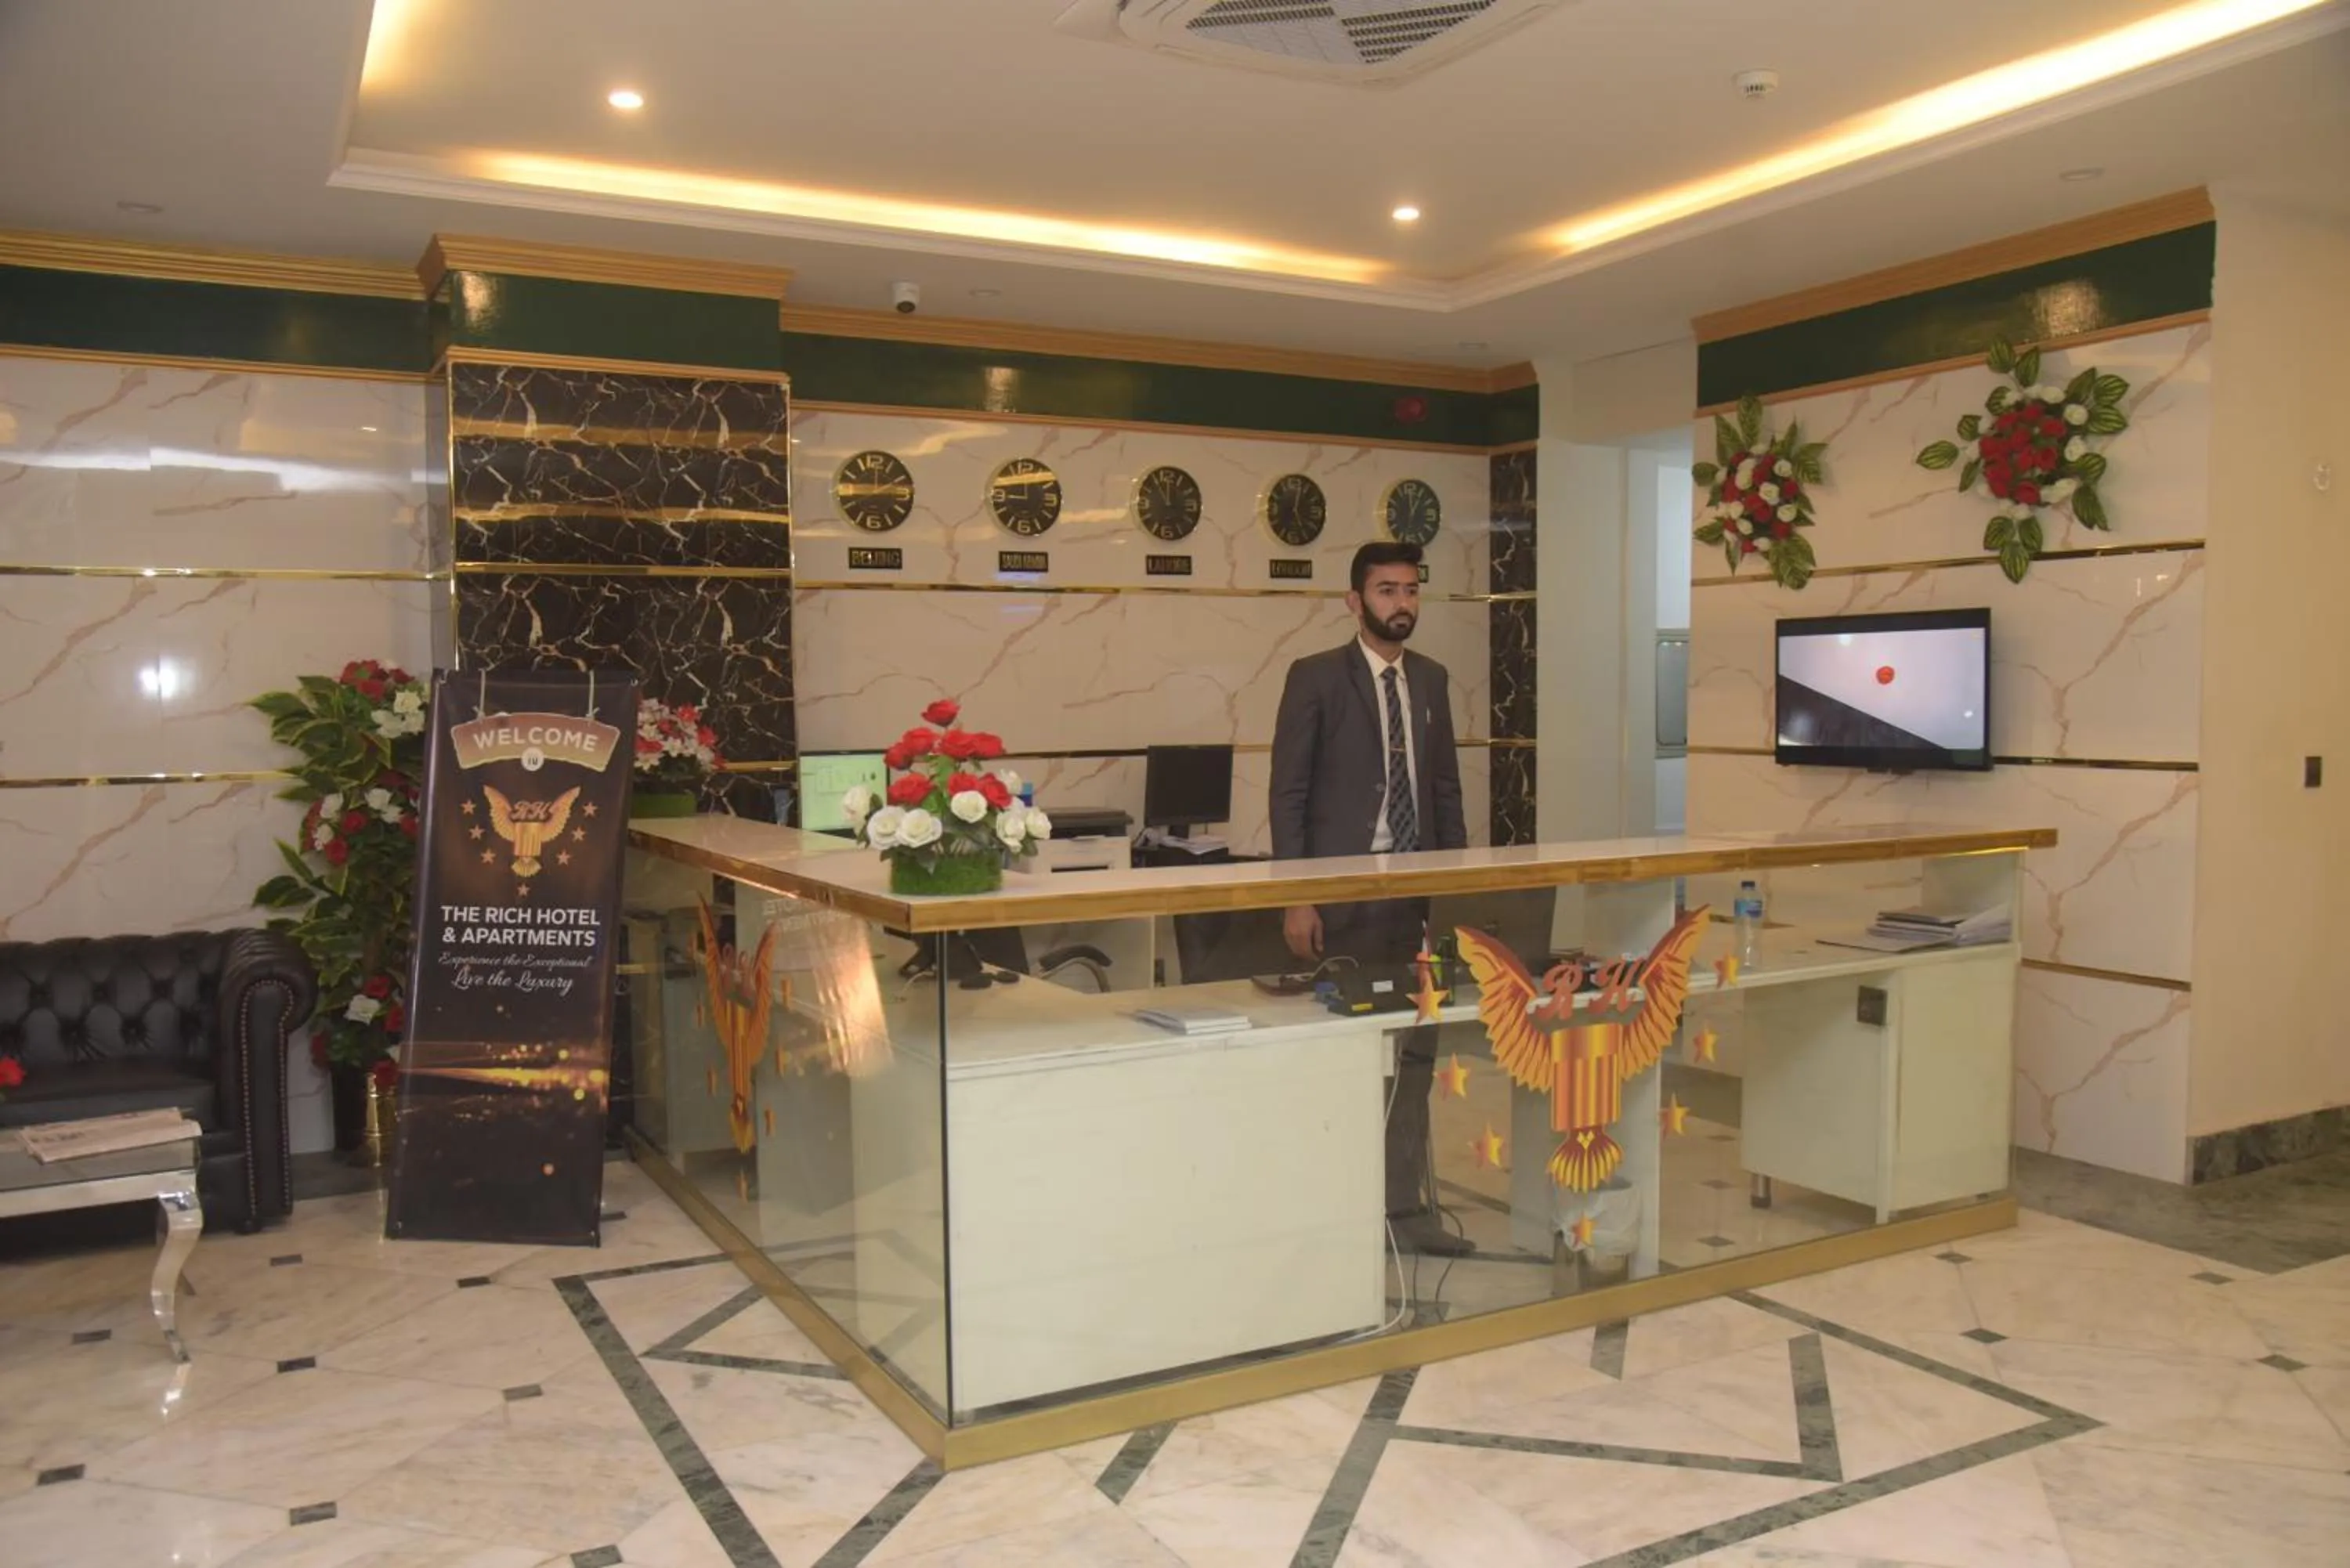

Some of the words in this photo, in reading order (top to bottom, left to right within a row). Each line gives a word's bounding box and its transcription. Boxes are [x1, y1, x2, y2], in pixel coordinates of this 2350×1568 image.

[866, 455, 884, 470] 12
[895, 487, 910, 500] 3
[1043, 493, 1057, 507] 3
[866, 515, 881, 529] 6
[1018, 520, 1031, 533] 6
[473, 727, 598, 752] WELCOME
[441, 905, 479, 923] THE
[484, 906, 533, 924] RICH
[537, 908, 601, 926] HOTEL
[442, 927, 456, 944] &
[461, 927, 596, 947] APARTMENTS
[438, 951, 501, 970] Experience
[502, 953, 521, 966] the
[522, 954, 591, 971] Exceptional
[451, 966, 484, 990] Live
[487, 969, 512, 987] the
[514, 970, 574, 997] Luxury
